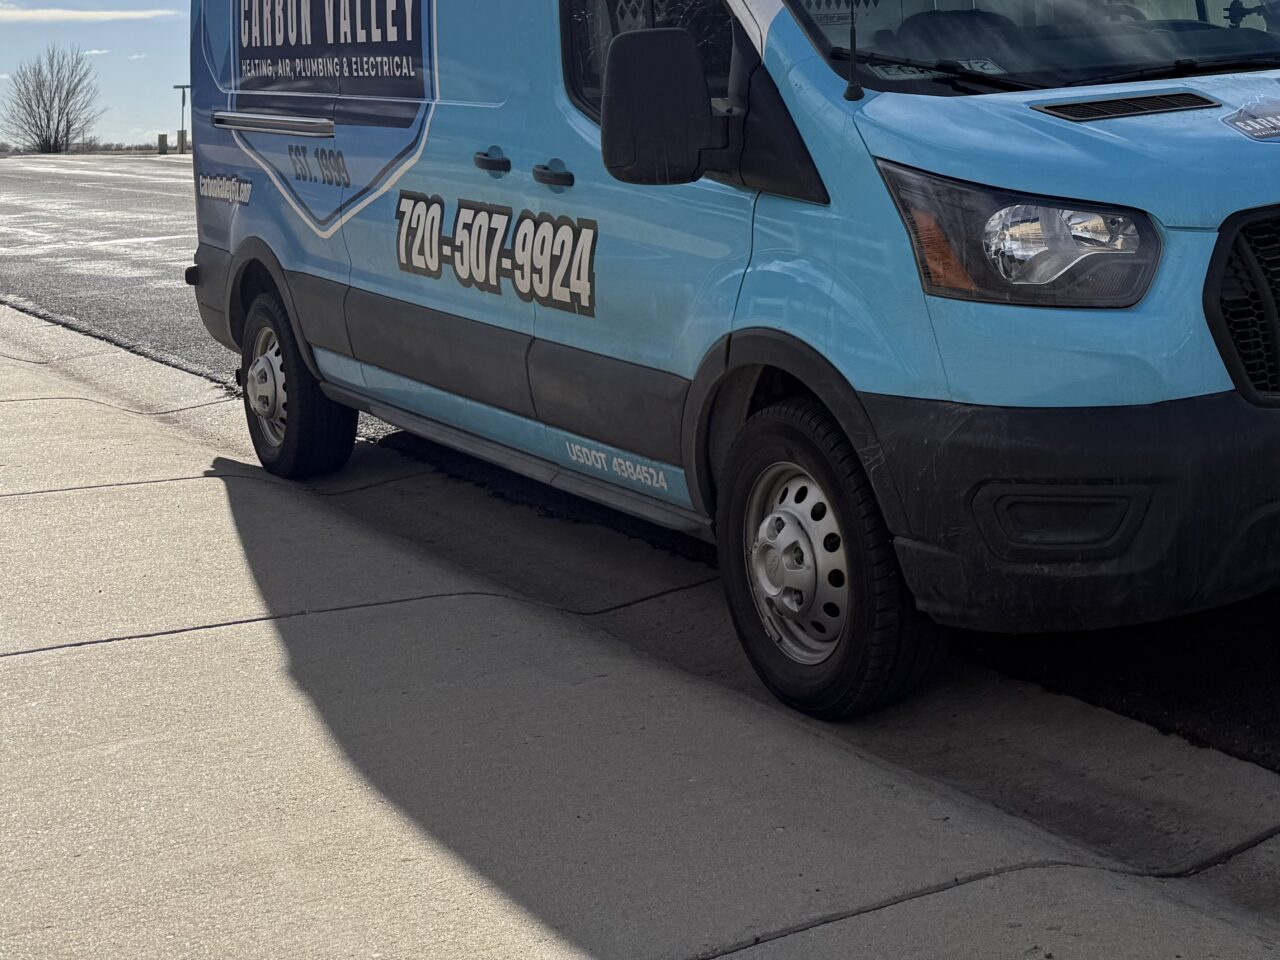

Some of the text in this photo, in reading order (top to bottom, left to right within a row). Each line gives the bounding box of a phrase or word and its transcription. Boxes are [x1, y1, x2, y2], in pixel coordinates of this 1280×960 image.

[242, 55, 416, 80] HEATING, AIR, PLUMBING & ELECTRICAL
[287, 144, 350, 188] EST. 1999
[399, 198, 595, 307] 720-507-9924
[565, 441, 668, 491] USDOT 4384524
